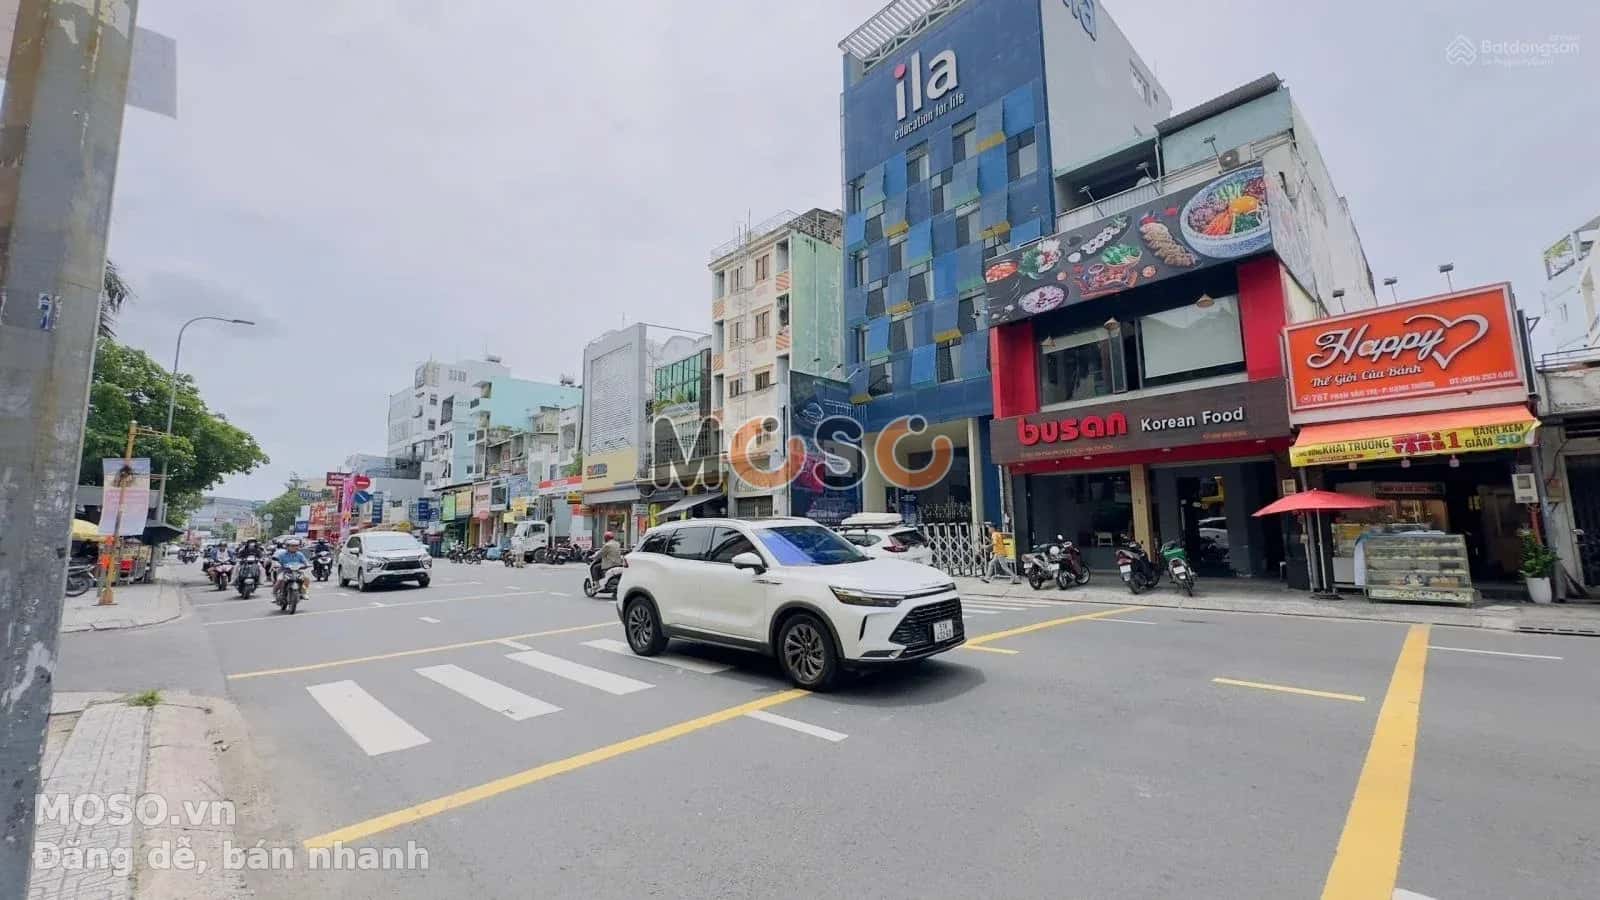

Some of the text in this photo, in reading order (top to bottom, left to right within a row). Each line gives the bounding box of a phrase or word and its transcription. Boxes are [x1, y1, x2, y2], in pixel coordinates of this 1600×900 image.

[894, 49, 959, 121] ila
[894, 92, 965, 140] education for life
[1306, 323, 1446, 368] Happy
[1312, 376, 1331, 388] Thế
[1334, 373, 1357, 386] Giới
[1389, 365, 1422, 378] Bánh
[1017, 407, 1244, 445] busan Korean Food
[1446, 431, 1463, 449] 1
[1322, 442, 1345, 455] KHAI
